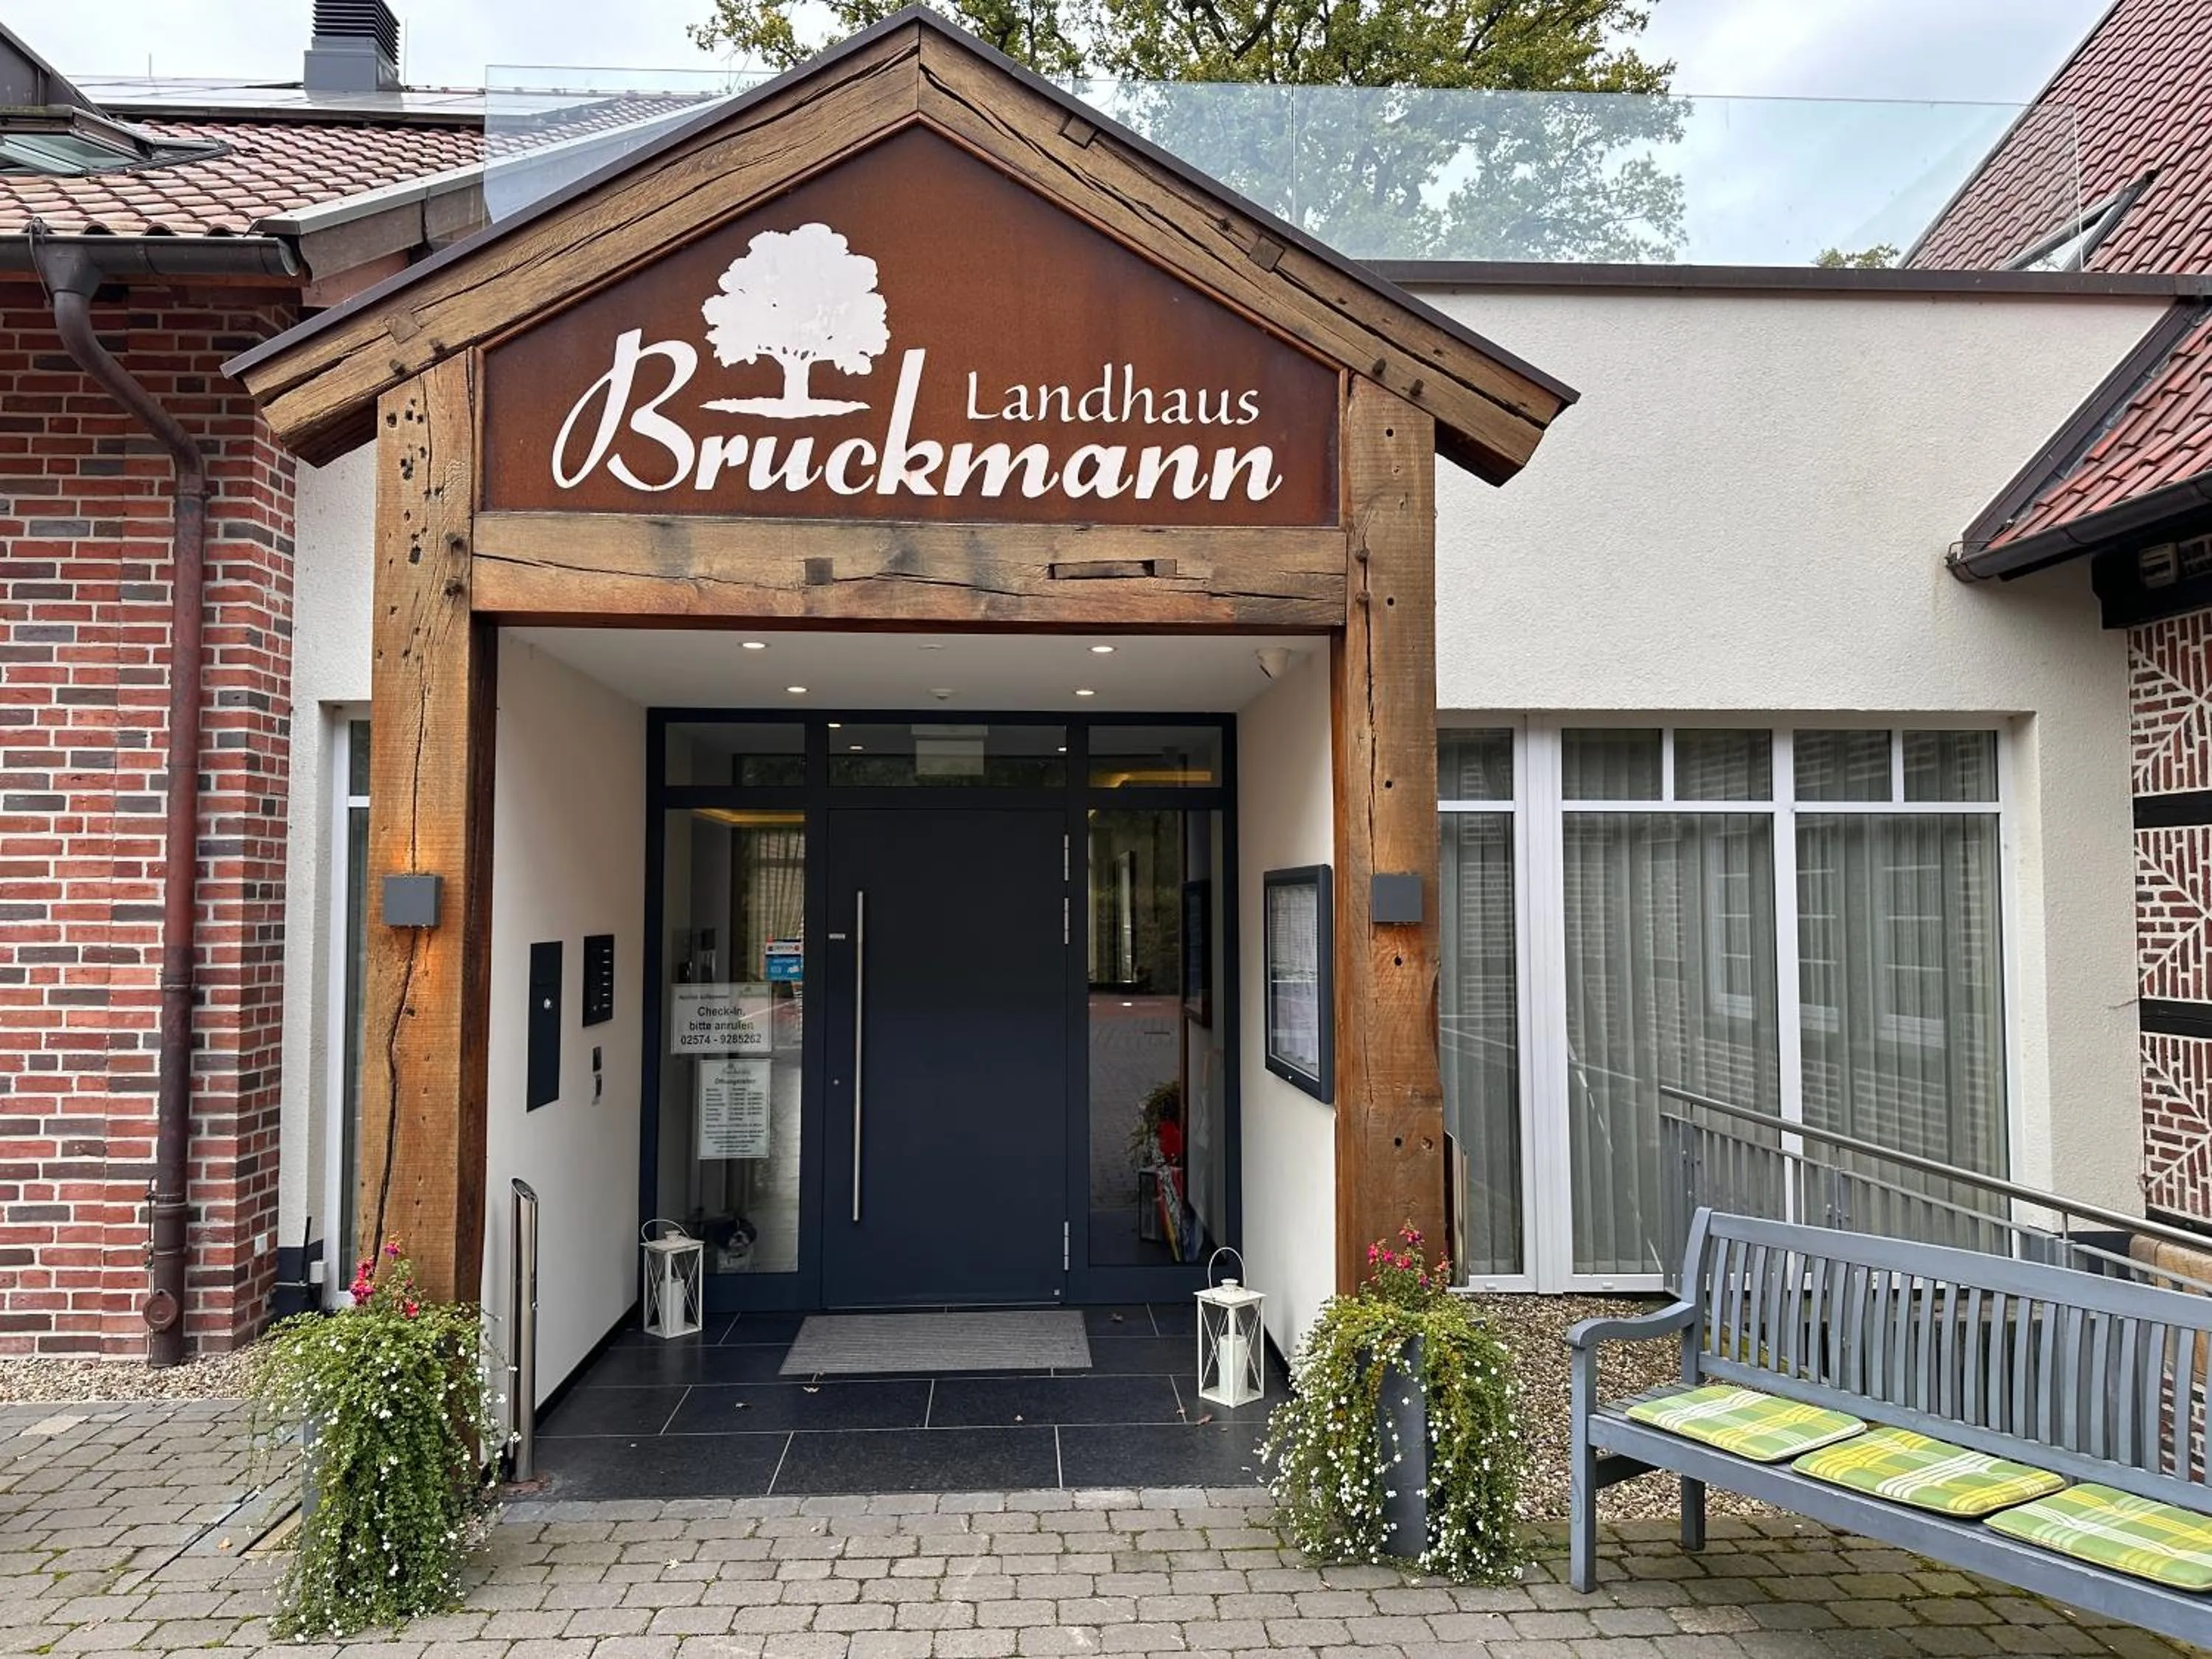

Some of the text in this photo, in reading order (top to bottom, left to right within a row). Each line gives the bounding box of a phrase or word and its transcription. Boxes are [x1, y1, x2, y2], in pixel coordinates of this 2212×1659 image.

[967, 364, 1259, 425] Landhaus
[552, 328, 1282, 501] Bruckmann
[681, 1034, 710, 1045] 02574
[689, 1020, 754, 1031] bitte anrufen
